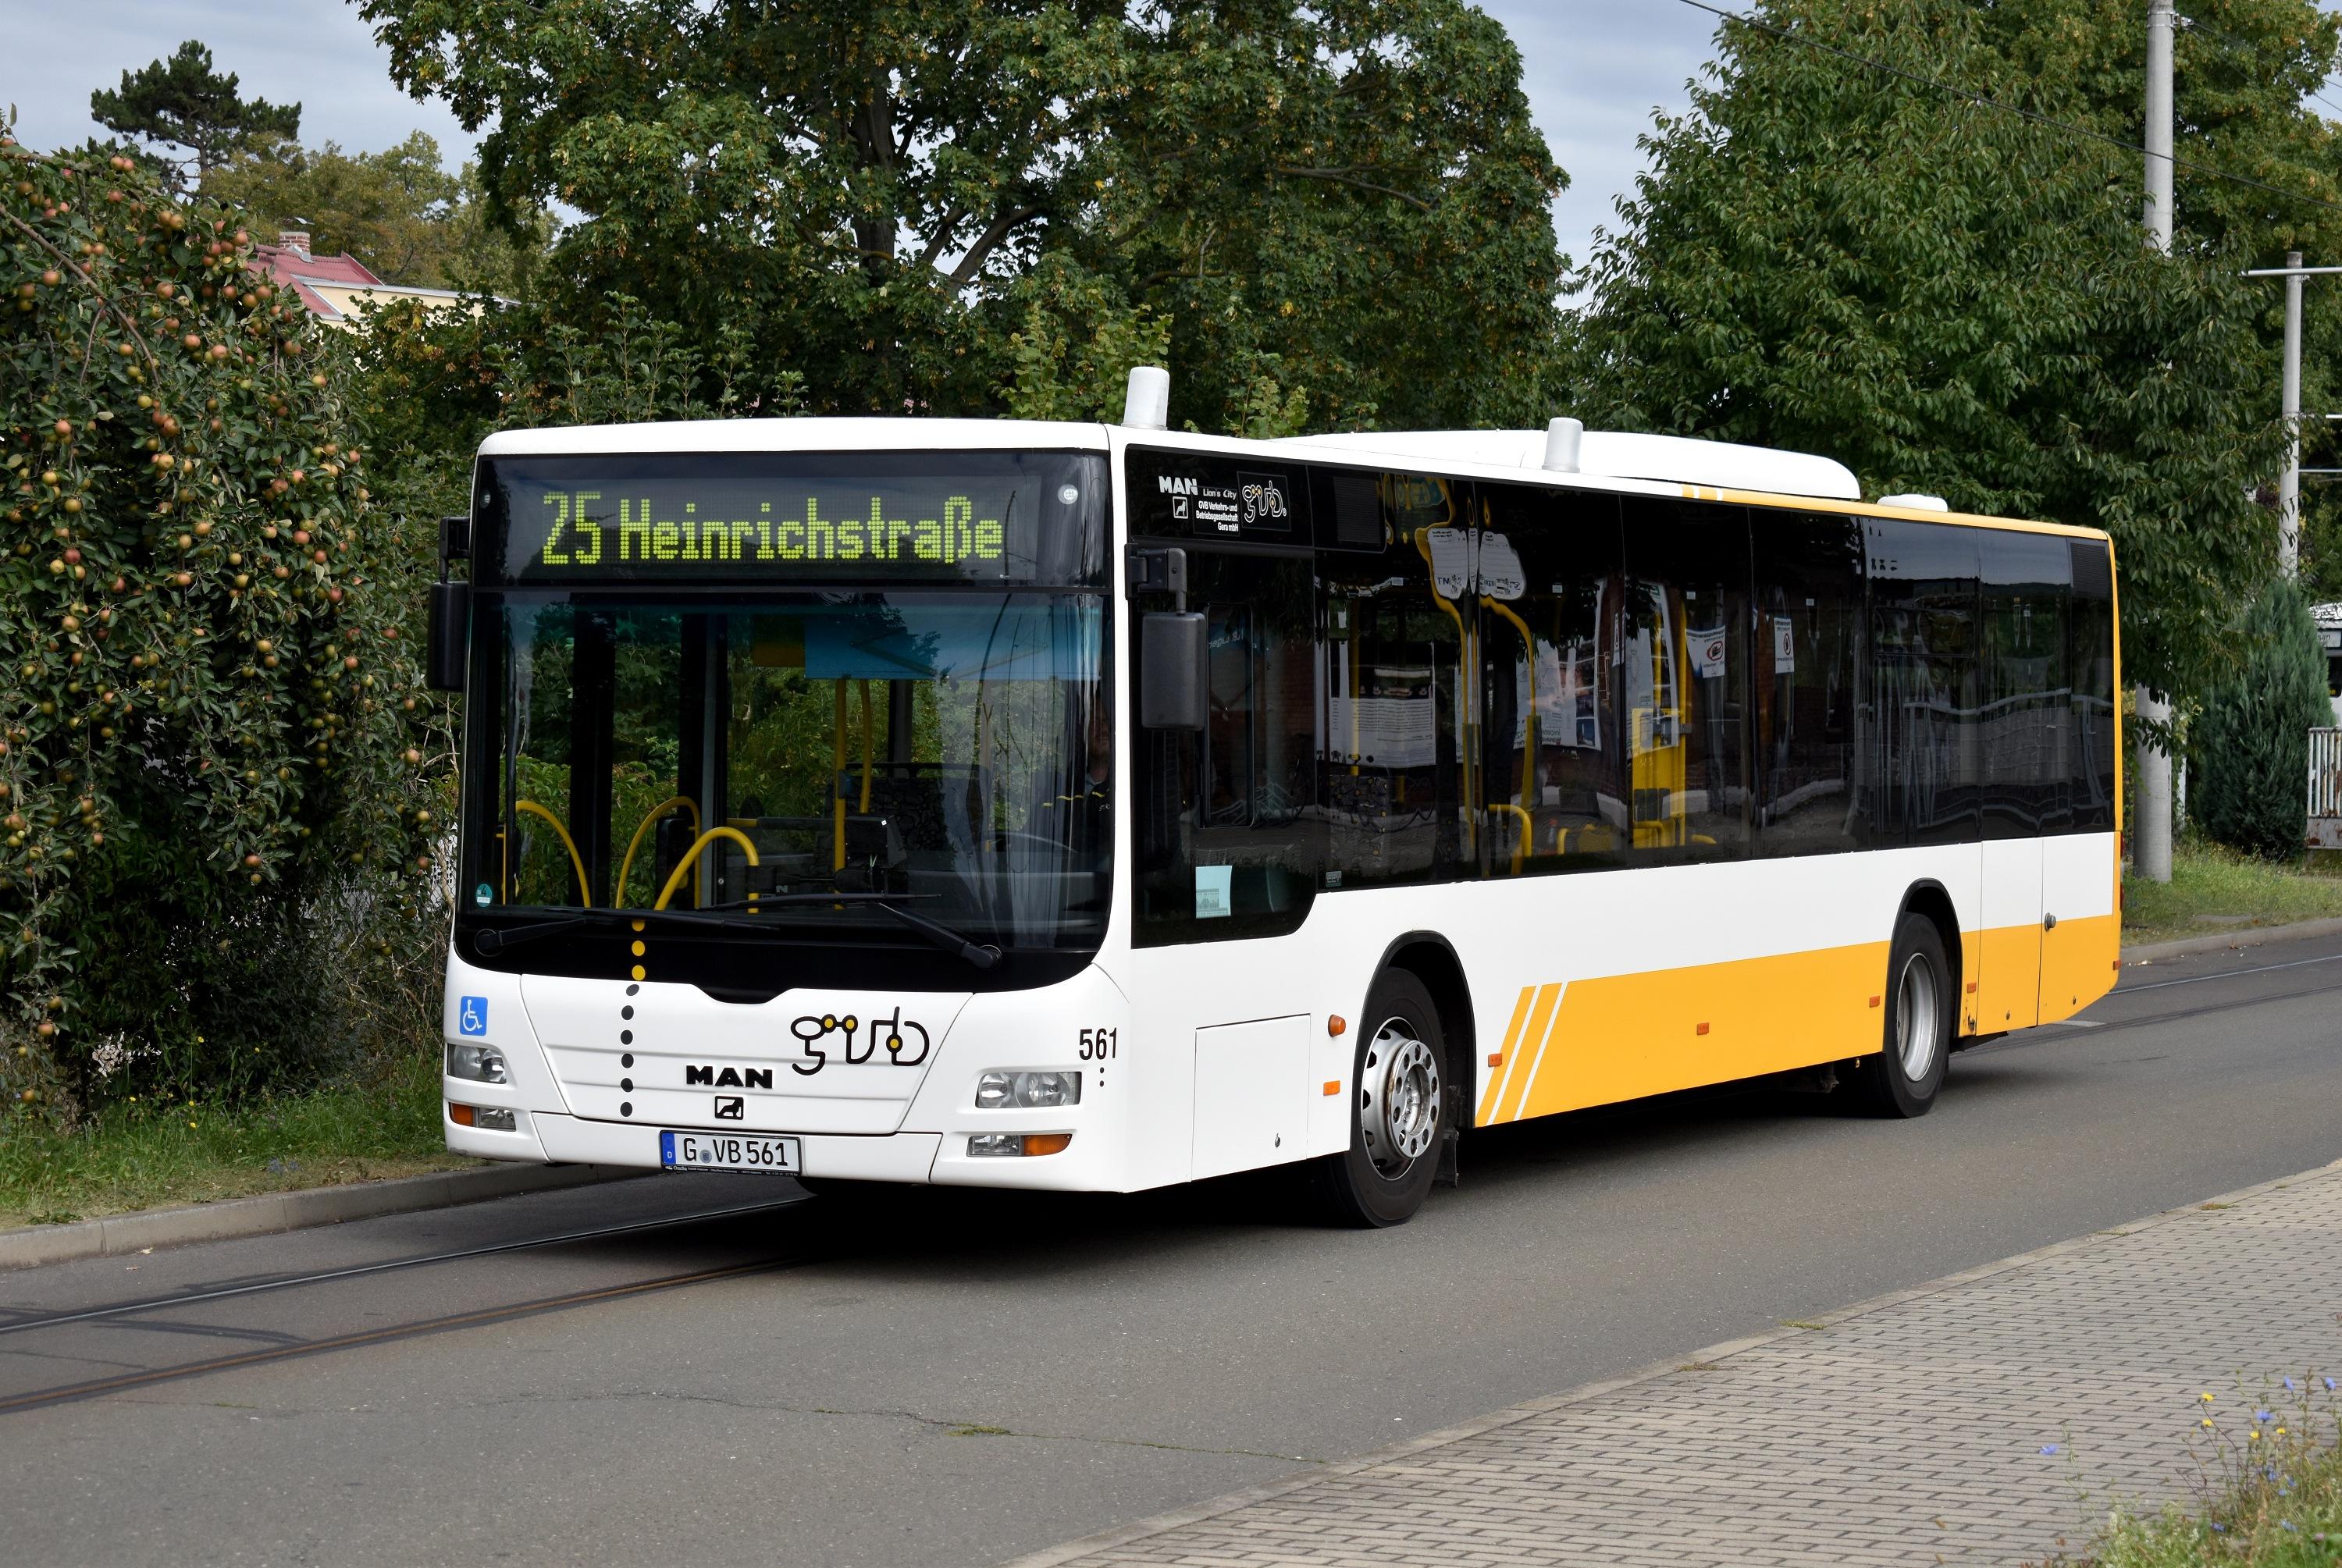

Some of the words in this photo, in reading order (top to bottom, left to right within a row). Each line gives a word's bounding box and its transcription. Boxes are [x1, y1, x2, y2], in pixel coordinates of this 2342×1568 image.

[1159, 475, 1198, 496] MAN
[1203, 488, 1221, 498] Lion's
[1223, 489, 1237, 500] City
[1195, 510, 1238, 522] Betriebsgesellschaft
[1198, 500, 1208, 510] GVB
[1208, 502, 1229, 511] Verkehrs-
[1229, 503, 1238, 512] und
[543, 490, 601, 564] 25
[621, 496, 1002, 564] Heinrichstraße
[1217, 521, 1229, 532] Gera
[1228, 523, 1239, 532] mbH
[1079, 1027, 1117, 1060] 561
[686, 1065, 773, 1089] MAN
[683, 1138, 697, 1161] G
[713, 1139, 741, 1164] VB
[746, 1140, 788, 1167] 561
